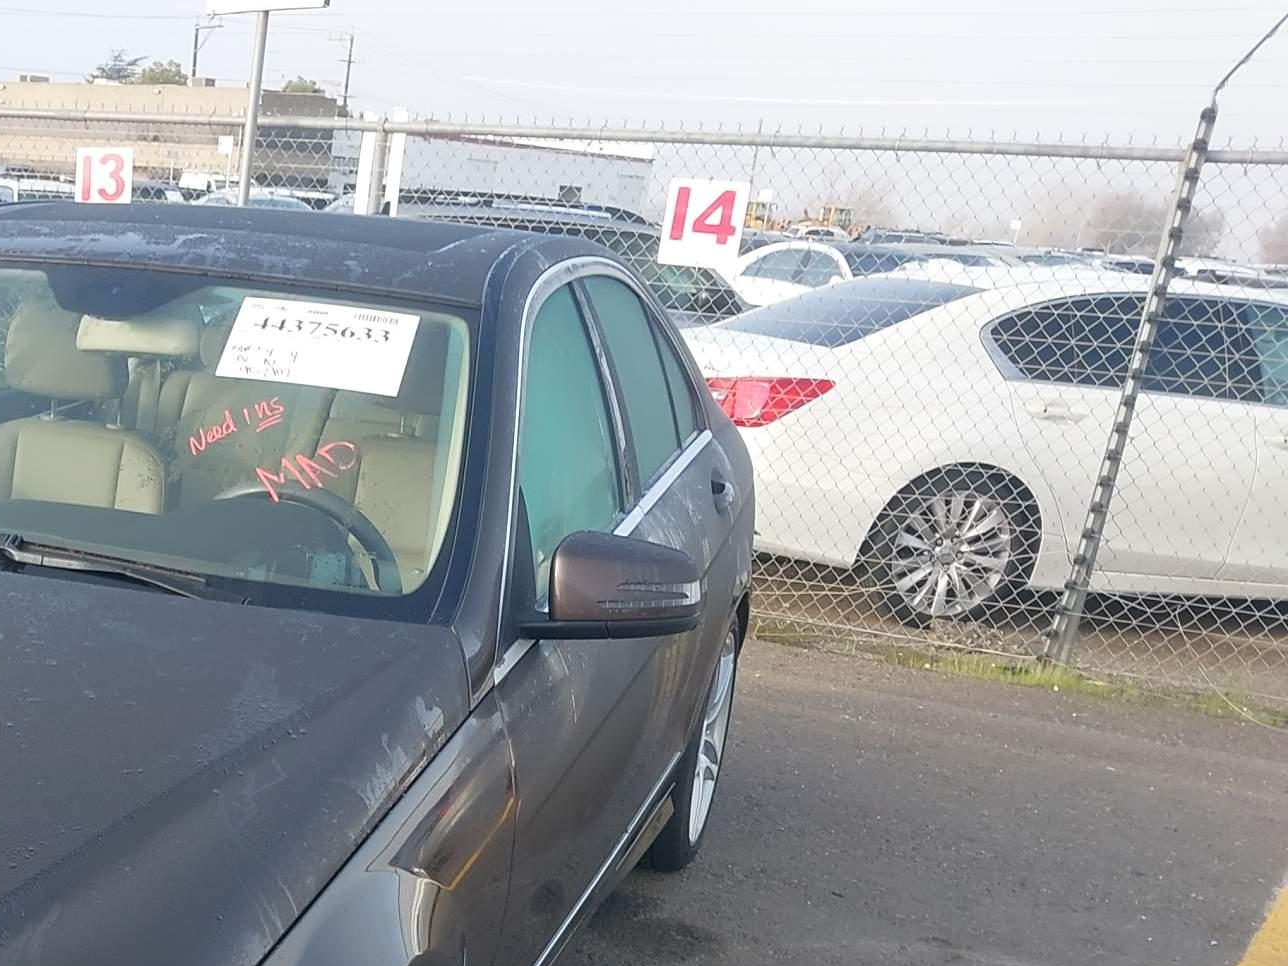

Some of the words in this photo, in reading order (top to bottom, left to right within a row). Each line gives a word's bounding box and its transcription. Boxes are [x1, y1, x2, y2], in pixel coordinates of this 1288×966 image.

[81, 153, 126, 202] 13
[669, 187, 737, 245] 14
[253, 316, 391, 344] 44375633
[188, 409, 238, 456] Need
